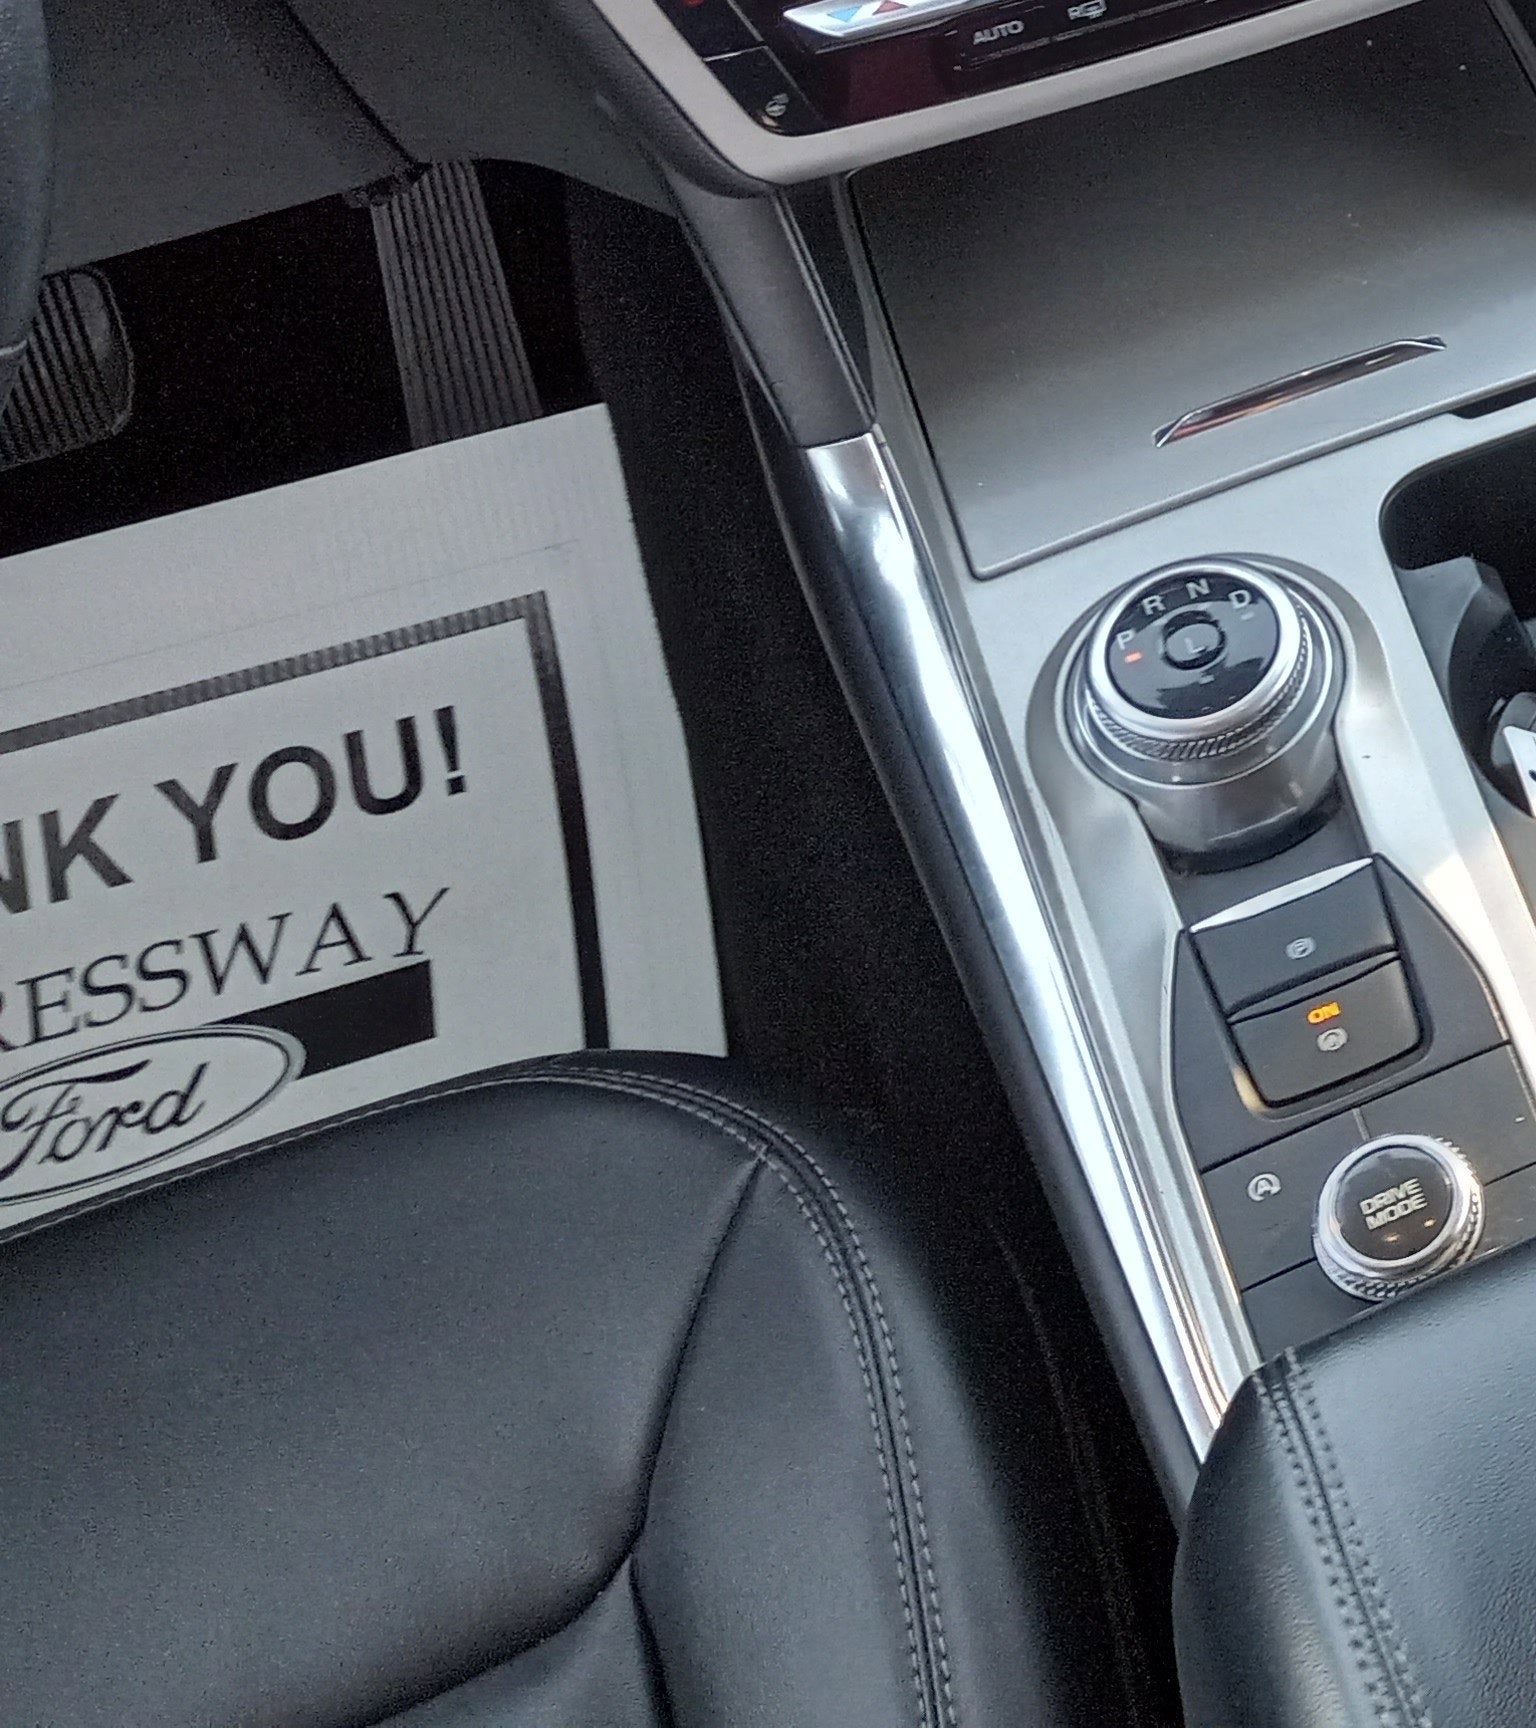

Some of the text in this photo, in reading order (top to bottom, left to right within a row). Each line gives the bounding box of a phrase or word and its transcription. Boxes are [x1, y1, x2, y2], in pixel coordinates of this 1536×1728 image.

[973, 20, 1025, 45] AUTO
[1116, 578, 1251, 650] P R N D
[155, 706, 467, 864] YOU!
[1307, 1002, 1341, 1024] ON
[1360, 1178, 1423, 1215] DRIVE
[1366, 1193, 1428, 1230] MODE
